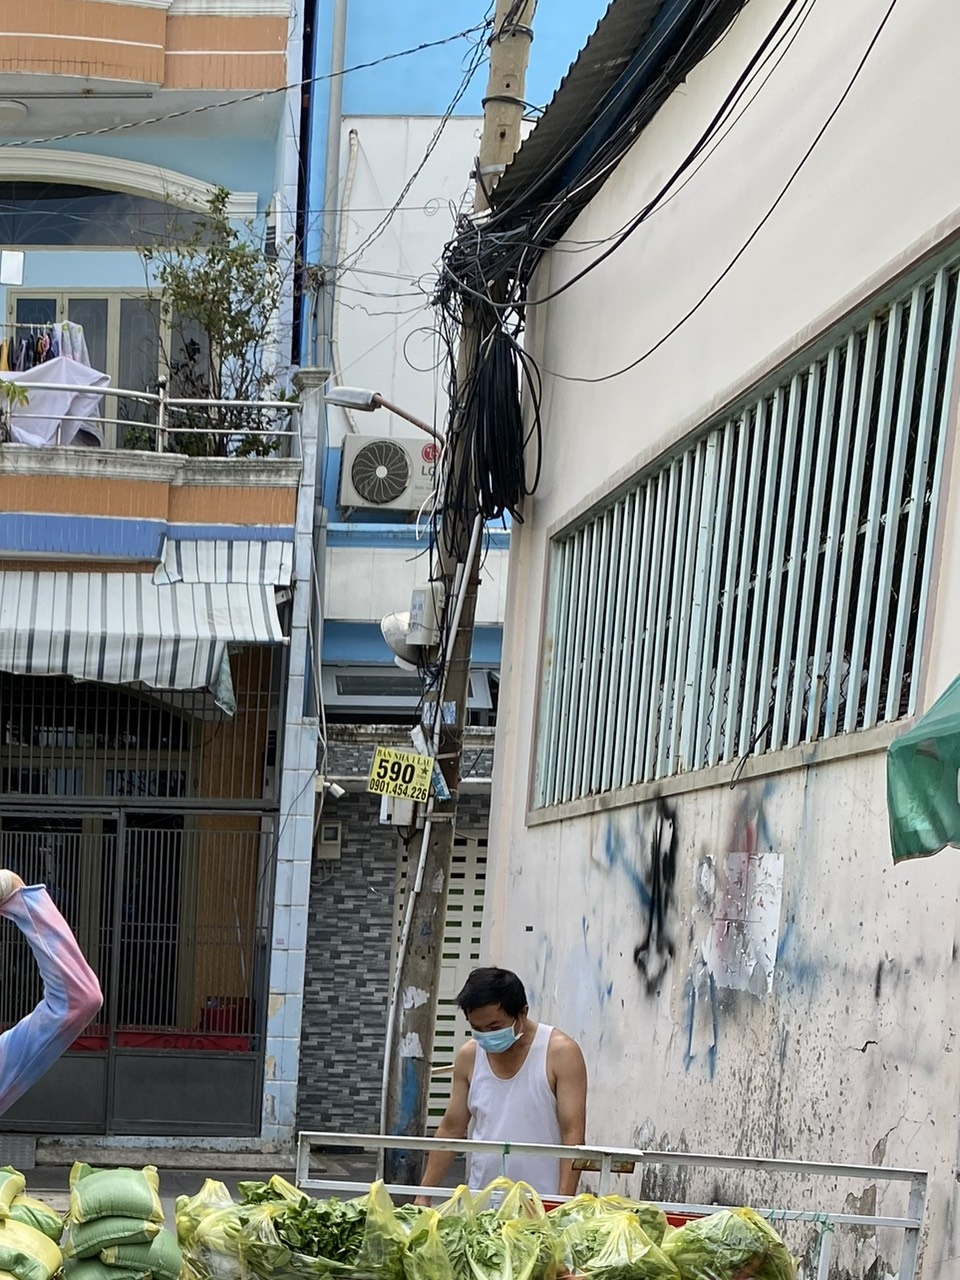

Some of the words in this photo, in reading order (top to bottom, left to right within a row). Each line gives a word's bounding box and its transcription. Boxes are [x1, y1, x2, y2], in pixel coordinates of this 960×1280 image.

[421, 465, 436, 477] LG
[376, 758, 416, 785] 590
[369, 778, 427, 800] 0901.454.226
